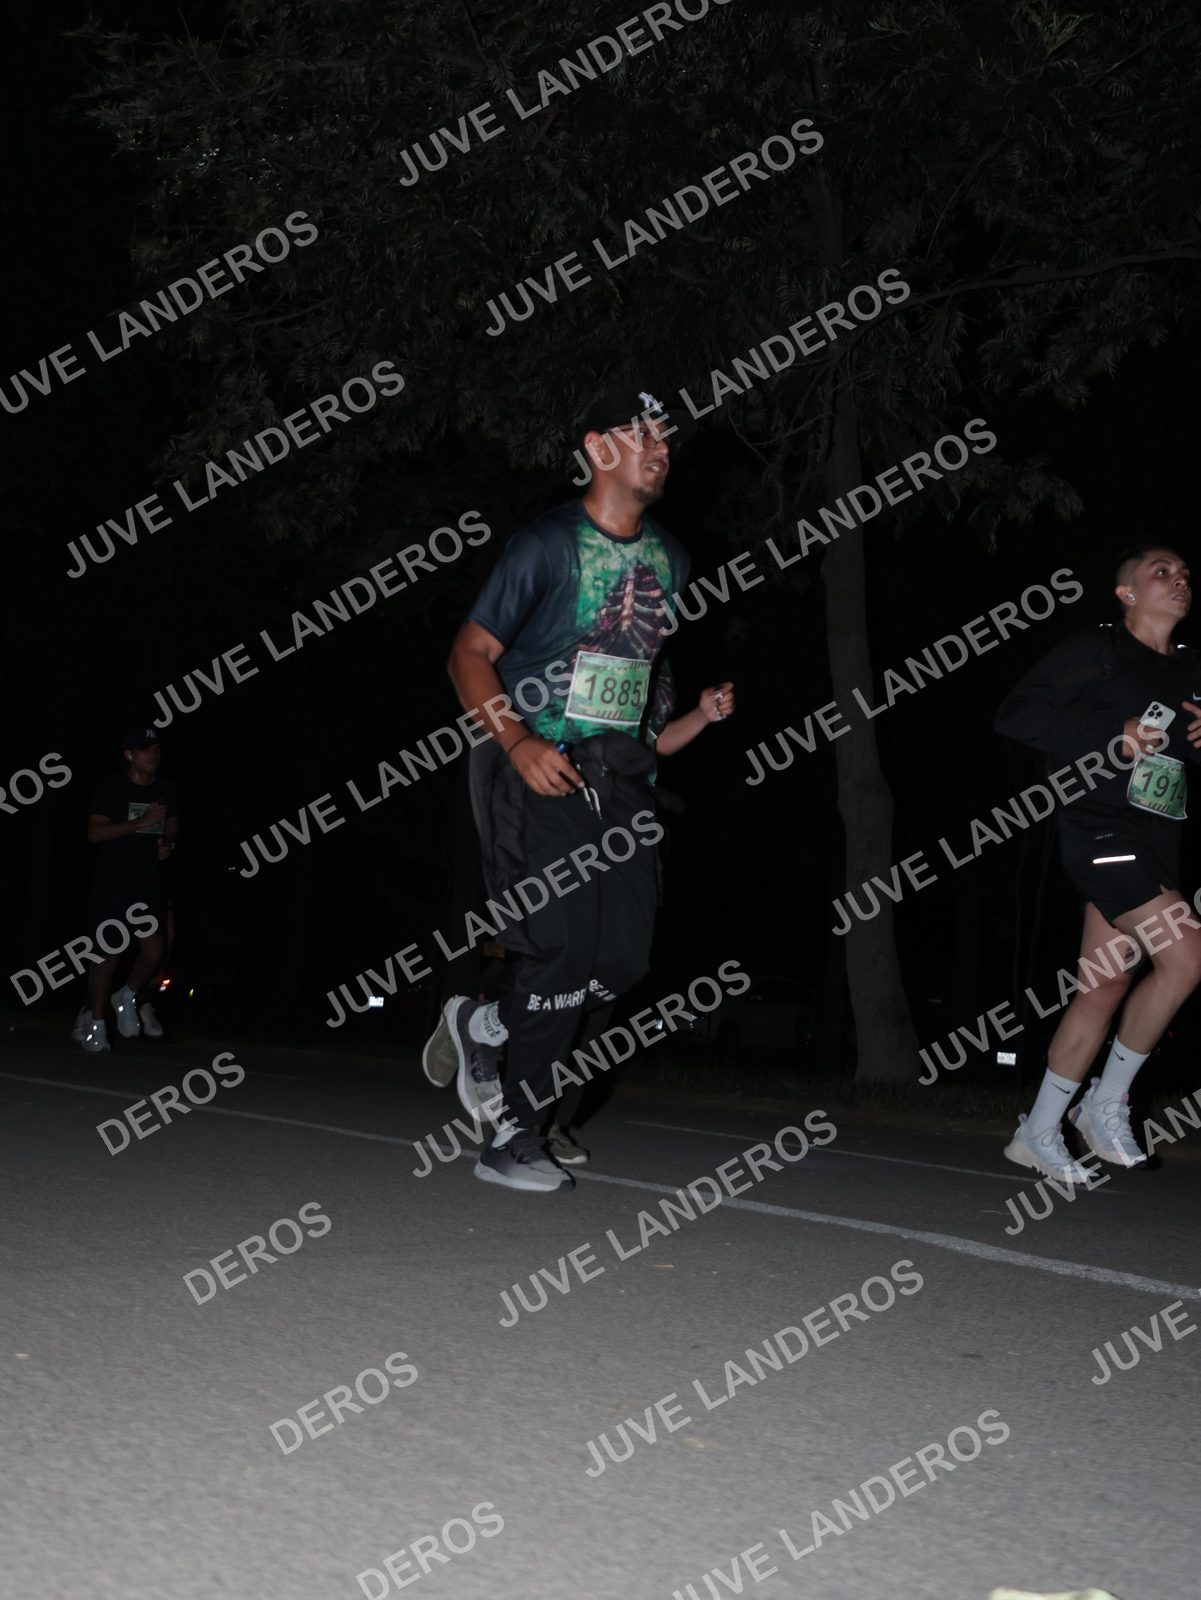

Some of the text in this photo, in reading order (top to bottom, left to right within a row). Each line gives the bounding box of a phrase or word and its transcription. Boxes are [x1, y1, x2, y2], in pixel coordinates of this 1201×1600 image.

[584, 673, 643, 708] 1885
[527, 993, 542, 1011] BE
[542, 997, 552, 1011] A
